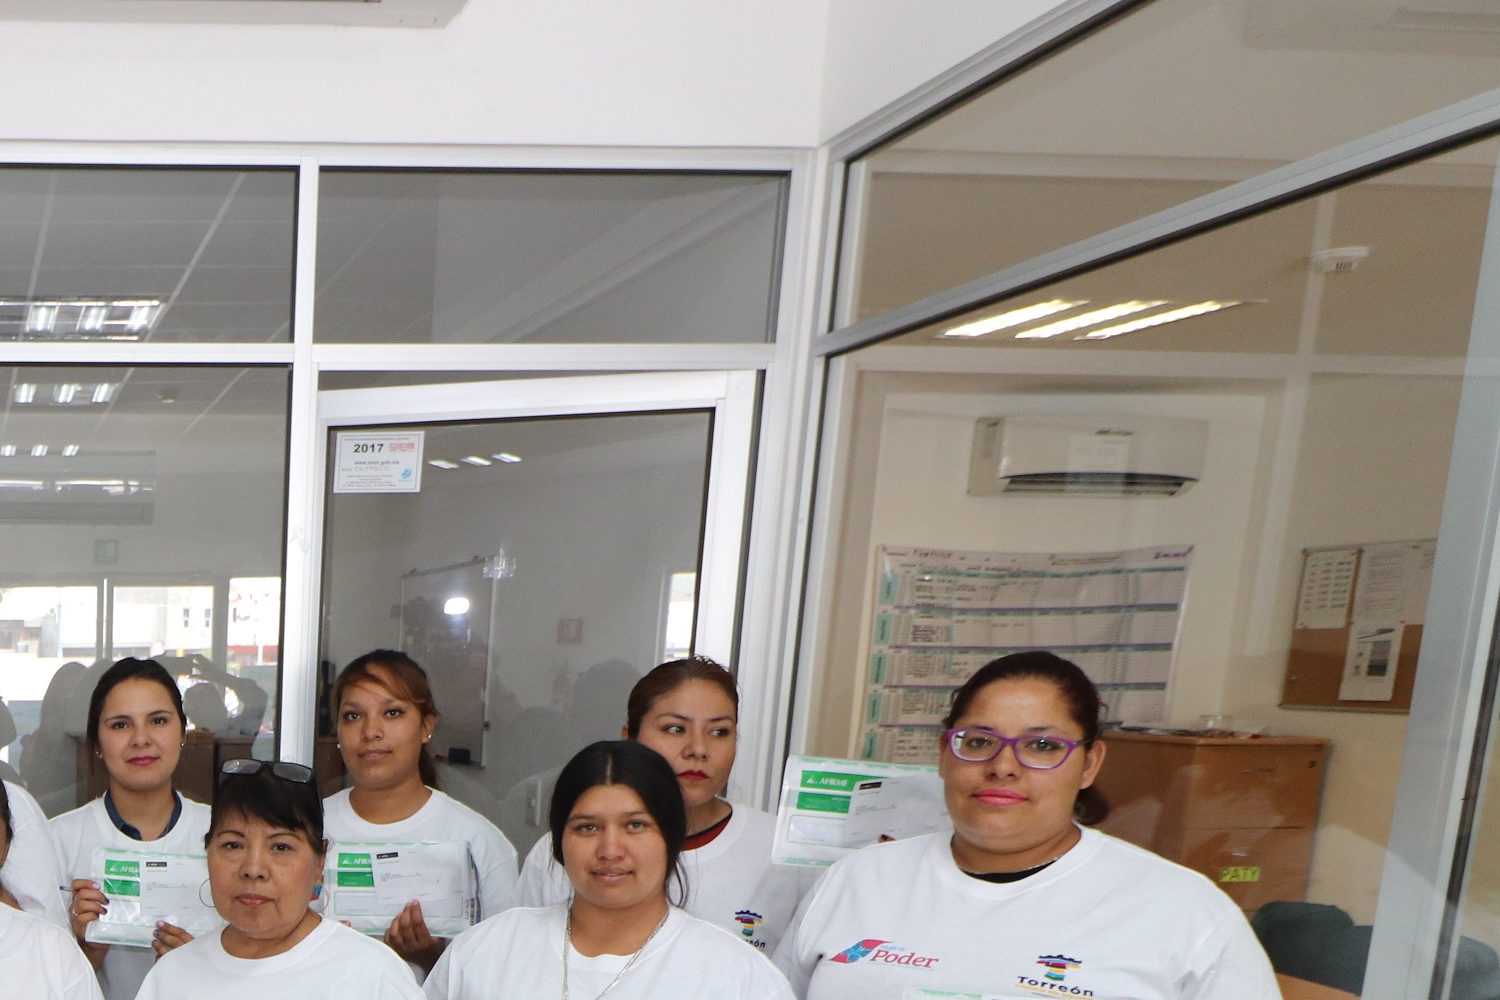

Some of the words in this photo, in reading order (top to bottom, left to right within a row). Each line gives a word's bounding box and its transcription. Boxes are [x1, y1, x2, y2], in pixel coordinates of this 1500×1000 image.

[353, 444, 384, 453] 2017
[820, 778, 847, 787] AFIRME
[869, 949, 939, 968] Poder
[1017, 976, 1093, 996] Torreón
